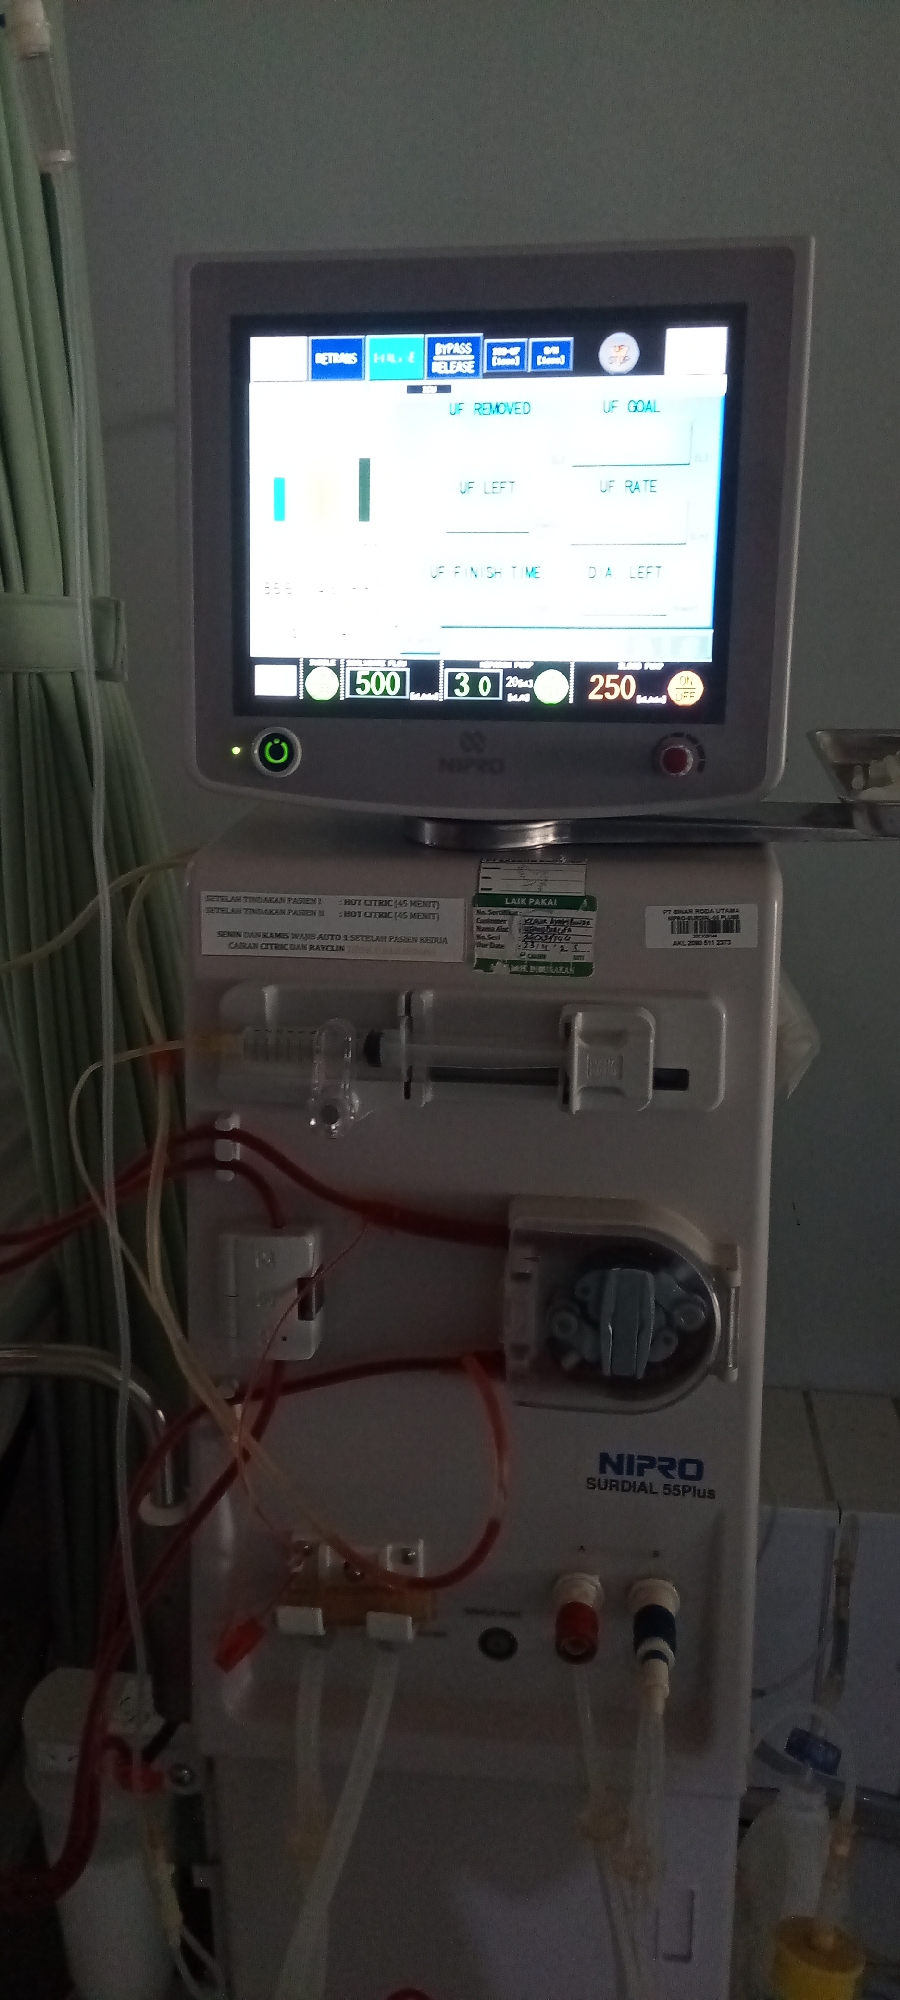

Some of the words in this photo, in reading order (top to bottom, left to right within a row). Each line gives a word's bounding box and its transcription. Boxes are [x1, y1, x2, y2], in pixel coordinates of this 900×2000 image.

[435, 341, 473, 356] BYPASS
[431, 360, 475, 374] RELEASE
[449, 402, 465, 415] UF
[475, 402, 531, 415] REMOVED
[603, 400, 618, 413] UF
[627, 400, 661, 413] GOAL
[459, 481, 475, 494] UF
[483, 481, 516, 494] LEFT
[600, 479, 615, 493] UF
[624, 479, 658, 493] RATE
[431, 566, 446, 579] UF
[454, 566, 502, 578] FINISH
[512, 566, 541, 578] TIME
[630, 566, 662, 578] LEFT
[355, 671, 401, 696] 500
[588, 674, 636, 700] 250
[679, 675, 693, 687] ON
[676, 691, 696, 702] OFF
[439, 757, 505, 775] NIPRO
[206, 895, 242, 903] SETELAH
[243, 896, 285, 904] TINDAKAN
[288, 897, 317, 905] PASIEN
[344, 899, 362, 907] HOT
[505, 897, 526, 906] LAIK
[528, 897, 558, 906] PAKAI
[206, 906, 242, 914] SETELAH
[243, 908, 285, 916] TINDAKAN
[288, 909, 316, 917] PASIEN
[364, 911, 393, 919] CITRIC
[218, 930, 242, 938] SENIN
[243, 931, 261, 939] DAN
[262, 932, 289, 940] KAMIS
[317, 933, 341, 942] AUTO
[350, 935, 387, 943] SETELAH
[389, 936, 418, 944] PASIEN
[420, 936, 449, 945] KEDUA
[228, 942, 258, 950] CAIRAN
[260, 943, 288, 951] CITRIC
[599, 1452, 704, 1482] NIPRO
[586, 1477, 658, 1495] SURDIAL
[662, 1483, 716, 1500] 55Plus
